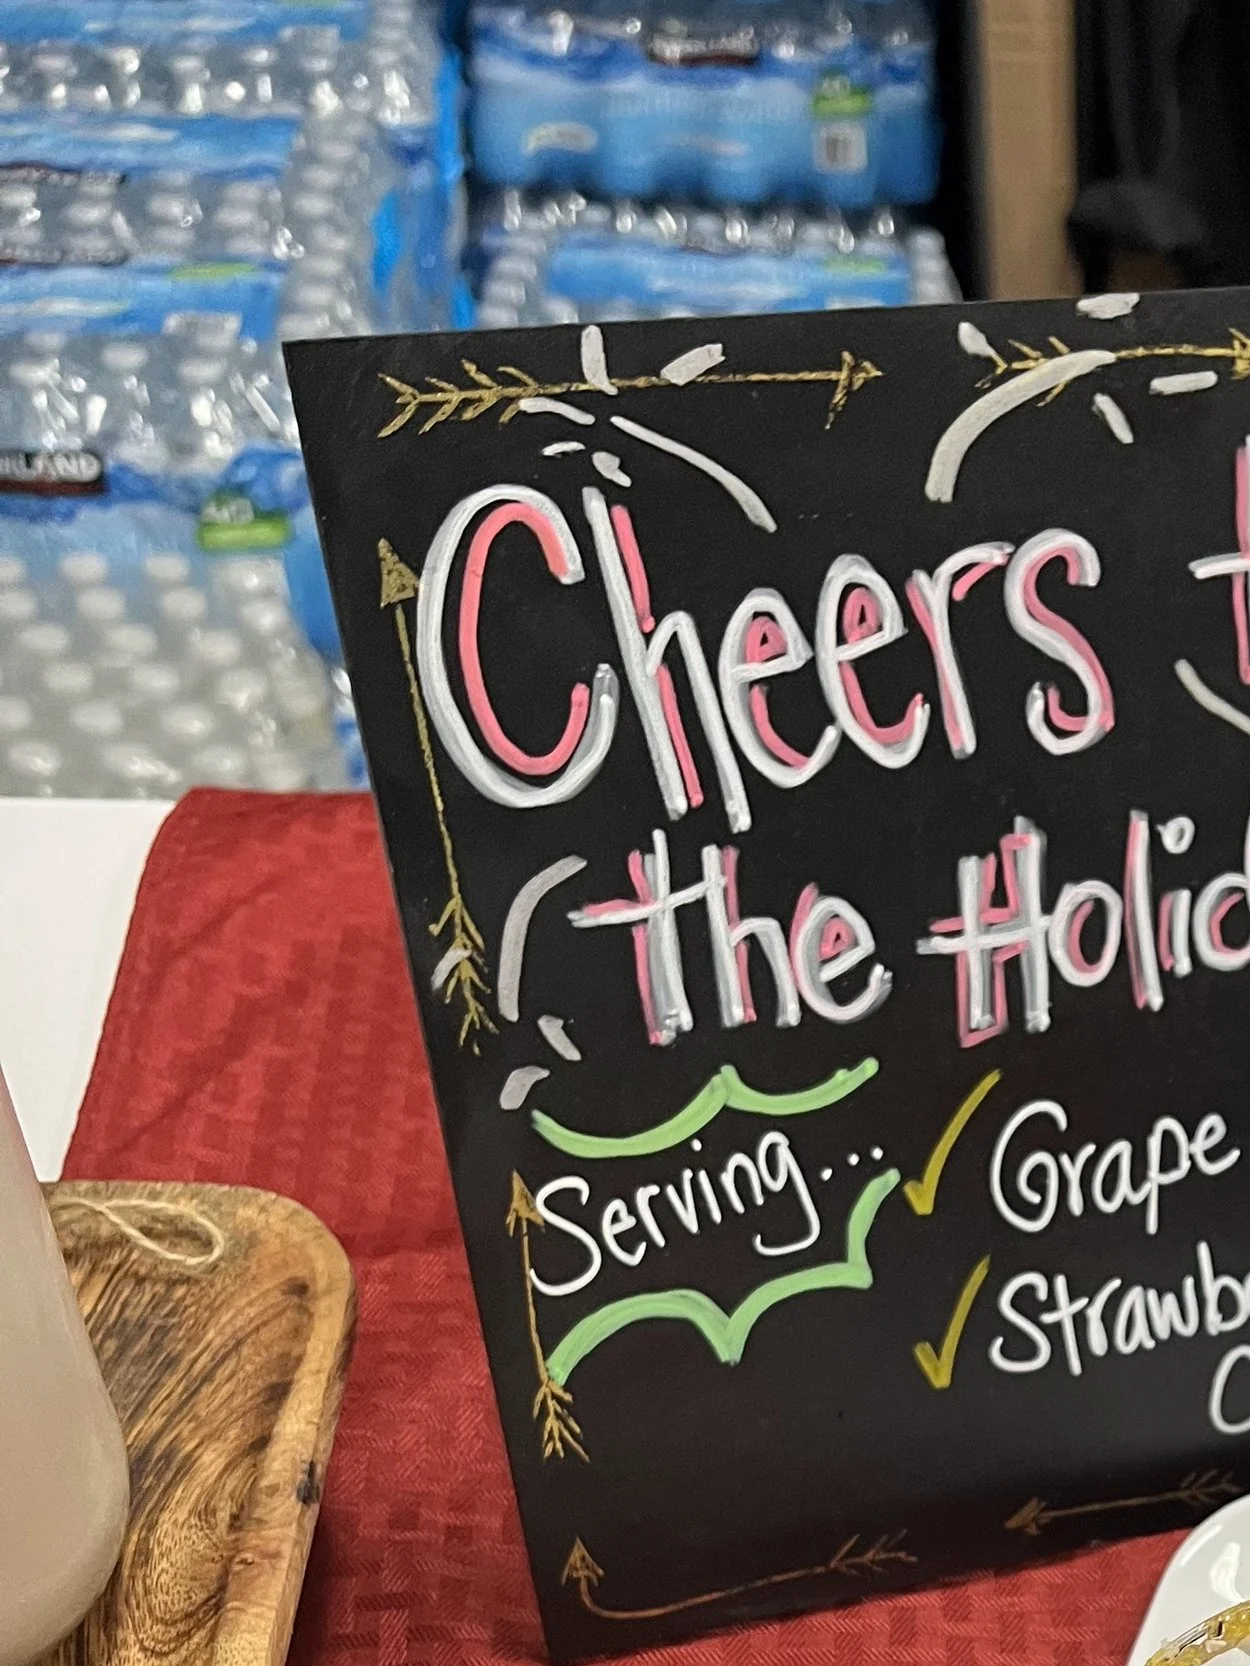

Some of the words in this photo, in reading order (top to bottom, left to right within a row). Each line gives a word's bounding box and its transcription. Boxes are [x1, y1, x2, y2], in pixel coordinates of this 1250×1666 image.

[416, 483, 1115, 833] Cheers
[566, 828, 894, 1046] the
[529, 1130, 885, 1297] Serving...
[990, 1100, 1241, 1235] Grape
